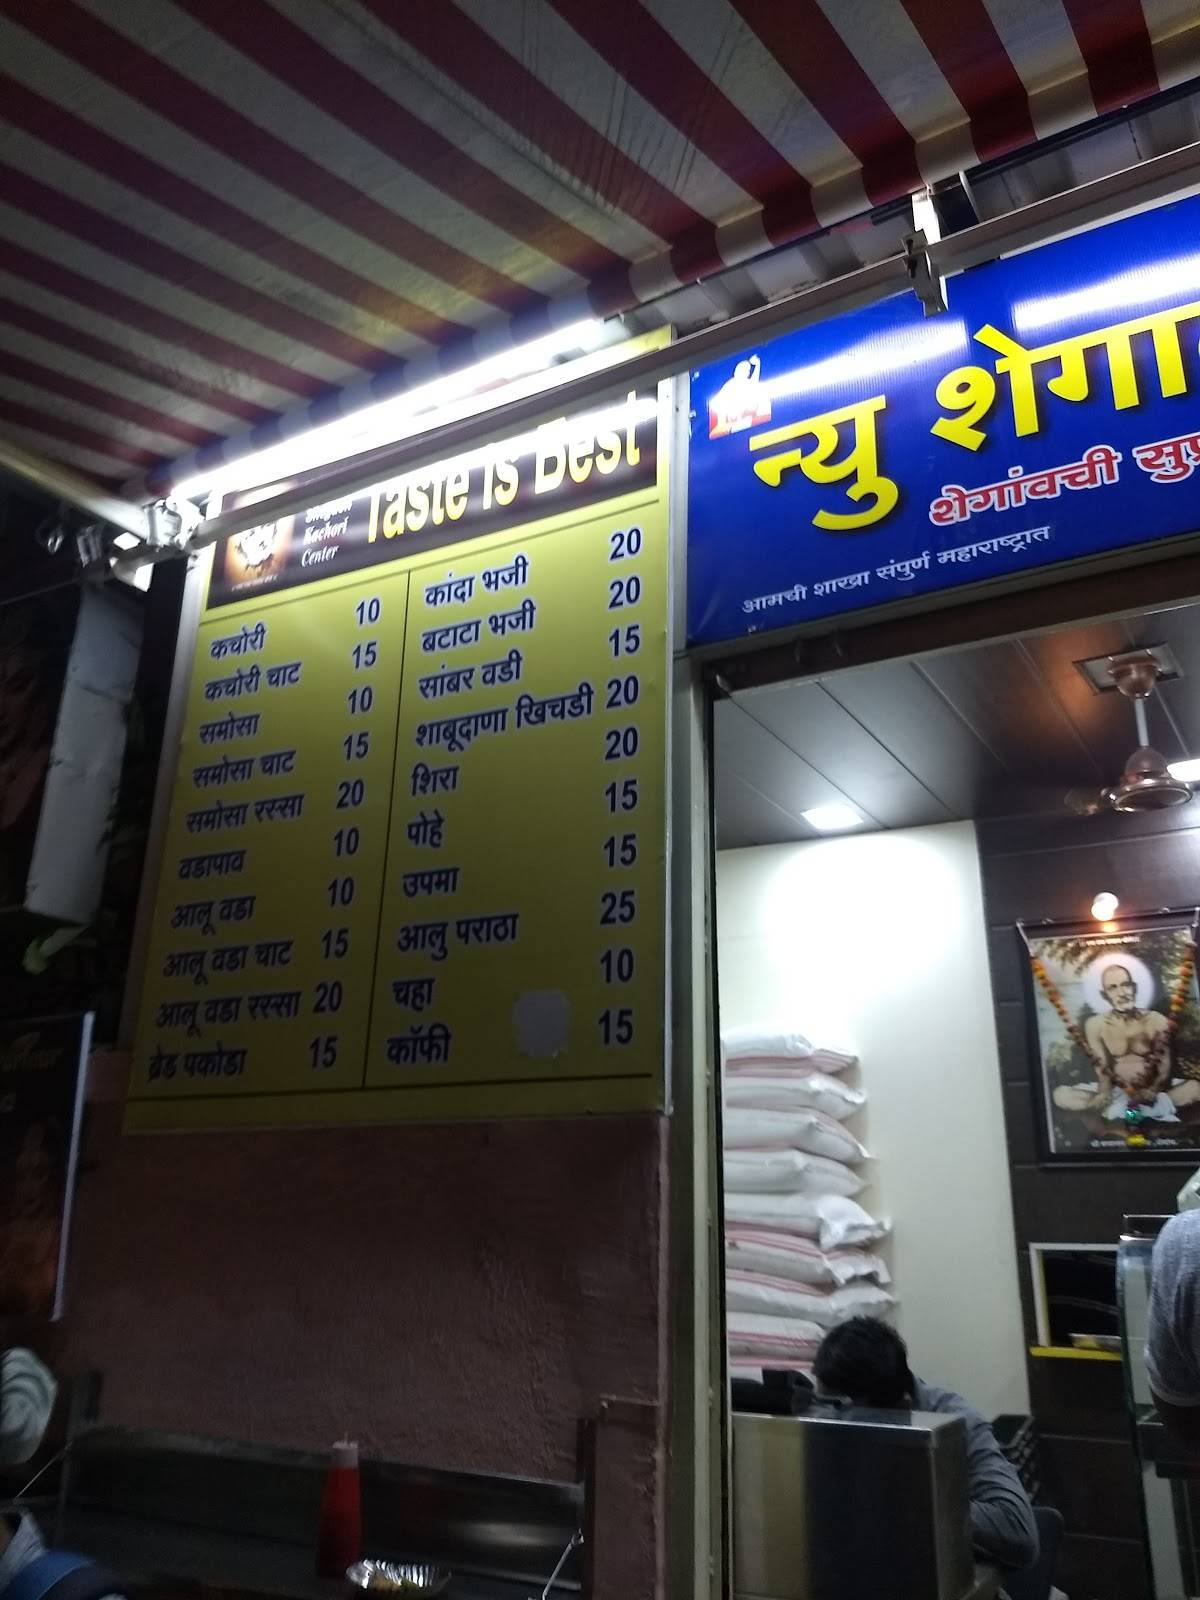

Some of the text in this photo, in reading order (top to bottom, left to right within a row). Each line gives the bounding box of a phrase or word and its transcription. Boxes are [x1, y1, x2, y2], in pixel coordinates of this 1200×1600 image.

[534, 390, 640, 494] Best
[748, 299, 1200, 532] न्यु शेगा
[929, 444, 1123, 527] शेगांवची
[301, 545, 339, 568] Center
[425, 528, 642, 607] कांदा भजी 20
[742, 525, 1051, 614] आमची शाखा संपुर्ण महाराष्ट्रात
[210, 598, 382, 661] कचोरी 10
[421, 576, 641, 652] बटाटा भजी 20
[204, 640, 378, 702] कचोरी चाट 15
[418, 624, 641, 699] सांबर वडी 15
[198, 685, 373, 745] समोसा 10
[414, 674, 640, 753] शाबूदाणा खिचडी 20
[192, 731, 370, 789] समोसा चाट 15
[410, 726, 639, 797] शिरा 20
[185, 778, 365, 834] समोसा रस्सा 20
[406, 779, 638, 848] पोहे 15
[178, 827, 360, 880] वडापाव 10
[402, 833, 637, 898] उपमा 15
[170, 876, 355, 937] आलू वडा 10
[455, 913, 519, 945] पराठा
[600, 890, 636, 926] 25
[163, 927, 349, 986] आलू वडा चाट 15
[392, 948, 634, 1012] चहा 10
[155, 980, 343, 1039] आलू वडा रस्सा 20
[387, 1008, 633, 1065] कॉफी 15
[148, 1035, 338, 1084] ब्रेड पकोडा 15
